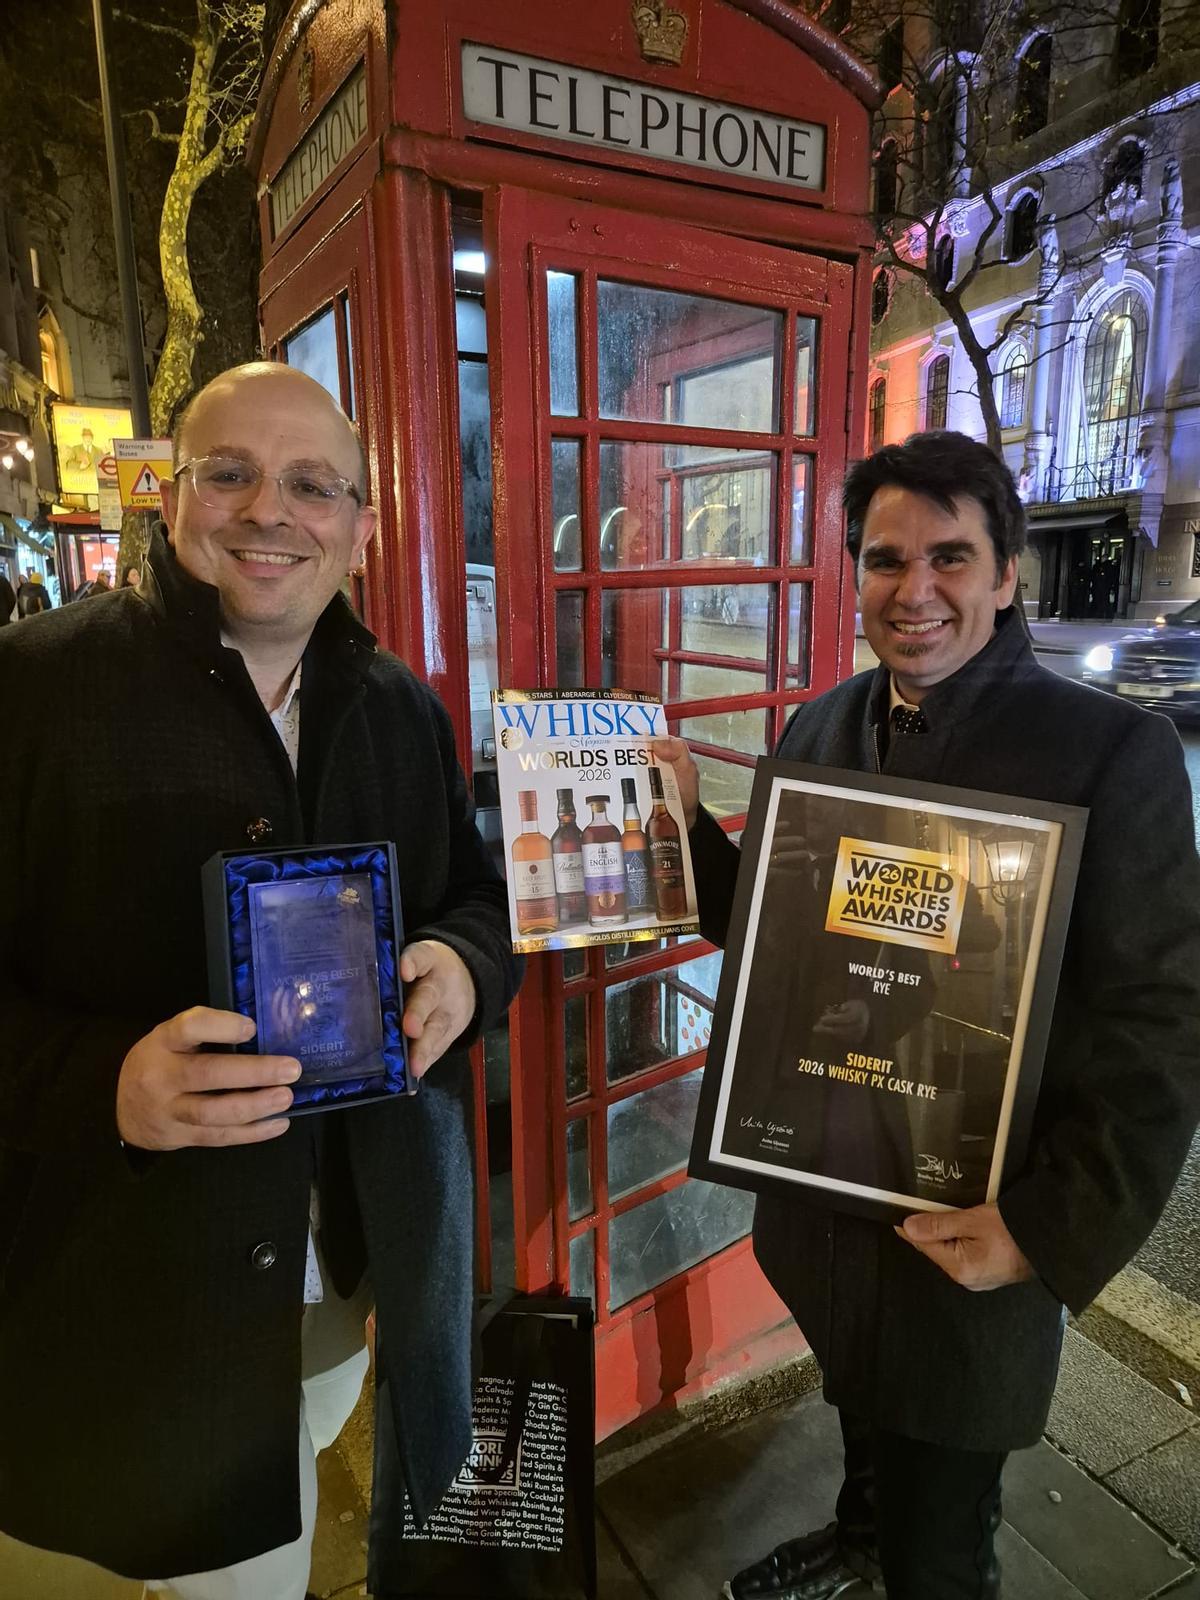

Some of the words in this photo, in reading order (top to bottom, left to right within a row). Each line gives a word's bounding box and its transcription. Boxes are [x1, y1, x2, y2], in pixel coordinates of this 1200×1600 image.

[476, 55, 810, 182] TELEPHONE
[274, 79, 368, 224] TELEPHONE
[497, 703, 661, 739] WHISKY
[518, 750, 608, 771] WORLD'S
[615, 749, 657, 766] BEST
[577, 769, 612, 781] 2026
[589, 858, 618, 867] ENGLISH
[847, 879, 951, 912] WHISKIES
[841, 898, 948, 932] AWARDS
[330, 967, 360, 980] BEST
[848, 962, 895, 982] WORLD'S
[897, 972, 921, 987] BEST
[872, 980, 891, 996] RYE
[300, 1040, 345, 1056] SIDERIT
[846, 1052, 894, 1075] SIDERIT
[798, 1058, 825, 1077] 2026
[828, 1064, 868, 1086] WHISKY
[870, 1073, 886, 1089] PX
[887, 1077, 914, 1096] CASK
[916, 1084, 938, 1101] RYE
[531, 1381, 546, 1390] ised
[503, 1397, 512, 1407] Sp
[538, 1402, 551, 1411] Gin
[528, 1410, 548, 1421] Ouzo
[524, 1420, 550, 1431] Shochu
[522, 1429, 548, 1441] Tequila
[548, 1431, 567, 1443] Verm
[522, 1440, 558, 1451] Armagnac
[540, 1452, 566, 1462] Calvad
[534, 1461, 556, 1472] Spirits
[557, 1464, 563, 1472] &
[533, 1472, 564, 1482] Madeira
[534, 1482, 549, 1491] Rum
[551, 1484, 565, 1493] Sak
[473, 1488, 492, 1496] Wine
[494, 1489, 528, 1500] Speciality
[529, 1491, 558, 1502] Cocktail
[439, 1504, 478, 1517] Aromatised
[480, 1509, 499, 1517] Wine
[501, 1509, 521, 1519] Baijiu
[522, 1510, 539, 1520] Beer
[462, 1498, 486, 1506] Vodka
[487, 1499, 519, 1507] Whiskies
[520, 1500, 550, 1512] Absinthe
[449, 1515, 493, 1529] Champagne
[494, 1518, 514, 1527] Cider
[515, 1520, 543, 1531] Cognac
[544, 1523, 564, 1533] Flavo
[430, 1523, 464, 1537] Speciality
[465, 1528, 479, 1537] Gin
[480, 1529, 501, 1538] Grain
[502, 1529, 522, 1539] Spirit
[523, 1531, 551, 1542] Grappa
[552, 1535, 563, 1545] Liq
